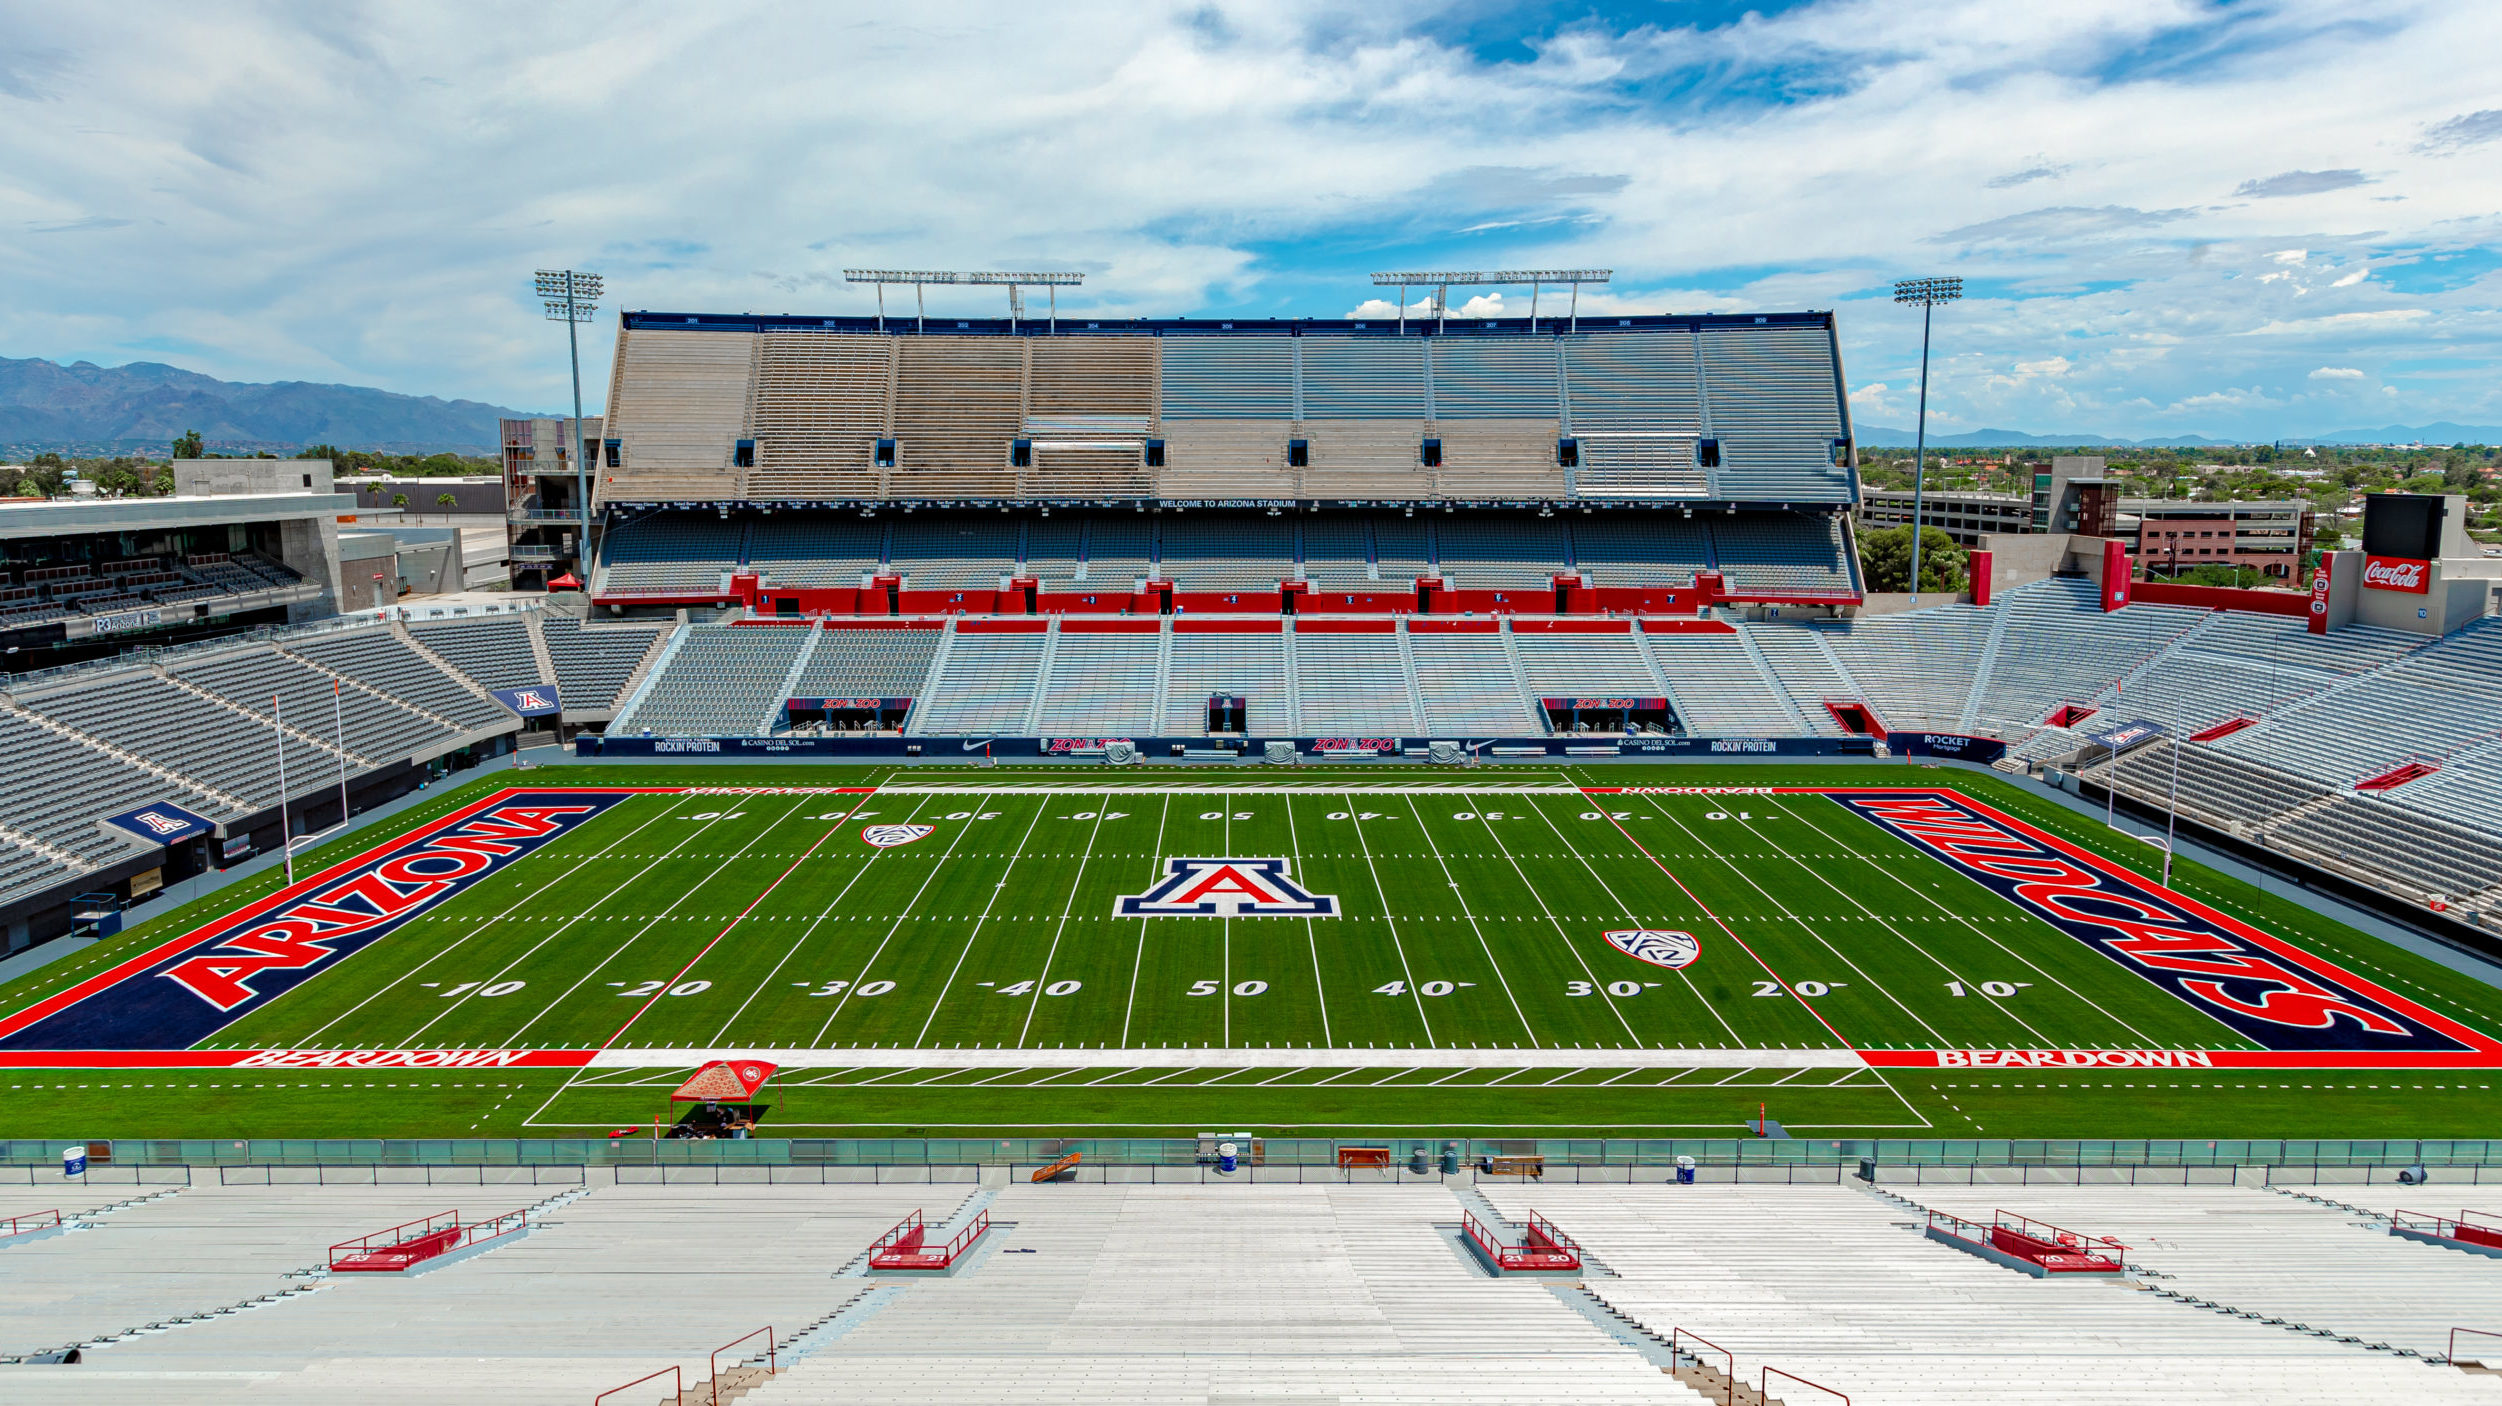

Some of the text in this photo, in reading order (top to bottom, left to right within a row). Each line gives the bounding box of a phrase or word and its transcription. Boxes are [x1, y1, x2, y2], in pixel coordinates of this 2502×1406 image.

[1159, 500, 1296, 508] WELCOME TO ARIZONA STADIUM
[2364, 561, 2425, 588] Coca-Cola
[2418, 609, 2427, 617] 10
[514, 690, 555, 712] A
[686, 741, 720, 752] PROTEIN
[1743, 741, 1776, 752] PROTEIN
[1924, 734, 1970, 747] ROCKET
[134, 811, 192, 835] A
[1112, 857, 1342, 918] A
[156, 805, 596, 1013] ARIZONA
[1849, 798, 2414, 1037] WILDCATS
[439, 981, 526, 997] 10
[616, 981, 712, 997] 20
[809, 981, 897, 997] 30
[996, 981, 1083, 997] 40
[1186, 981, 1269, 997] 50
[1371, 981, 1456, 997] 40
[1565, 981, 1641, 997] 30
[1751, 981, 1831, 997] 20
[1943, 981, 2017, 997] 10
[345, 1254, 371, 1262] 23
[2085, 1255, 2106, 1263] 19
